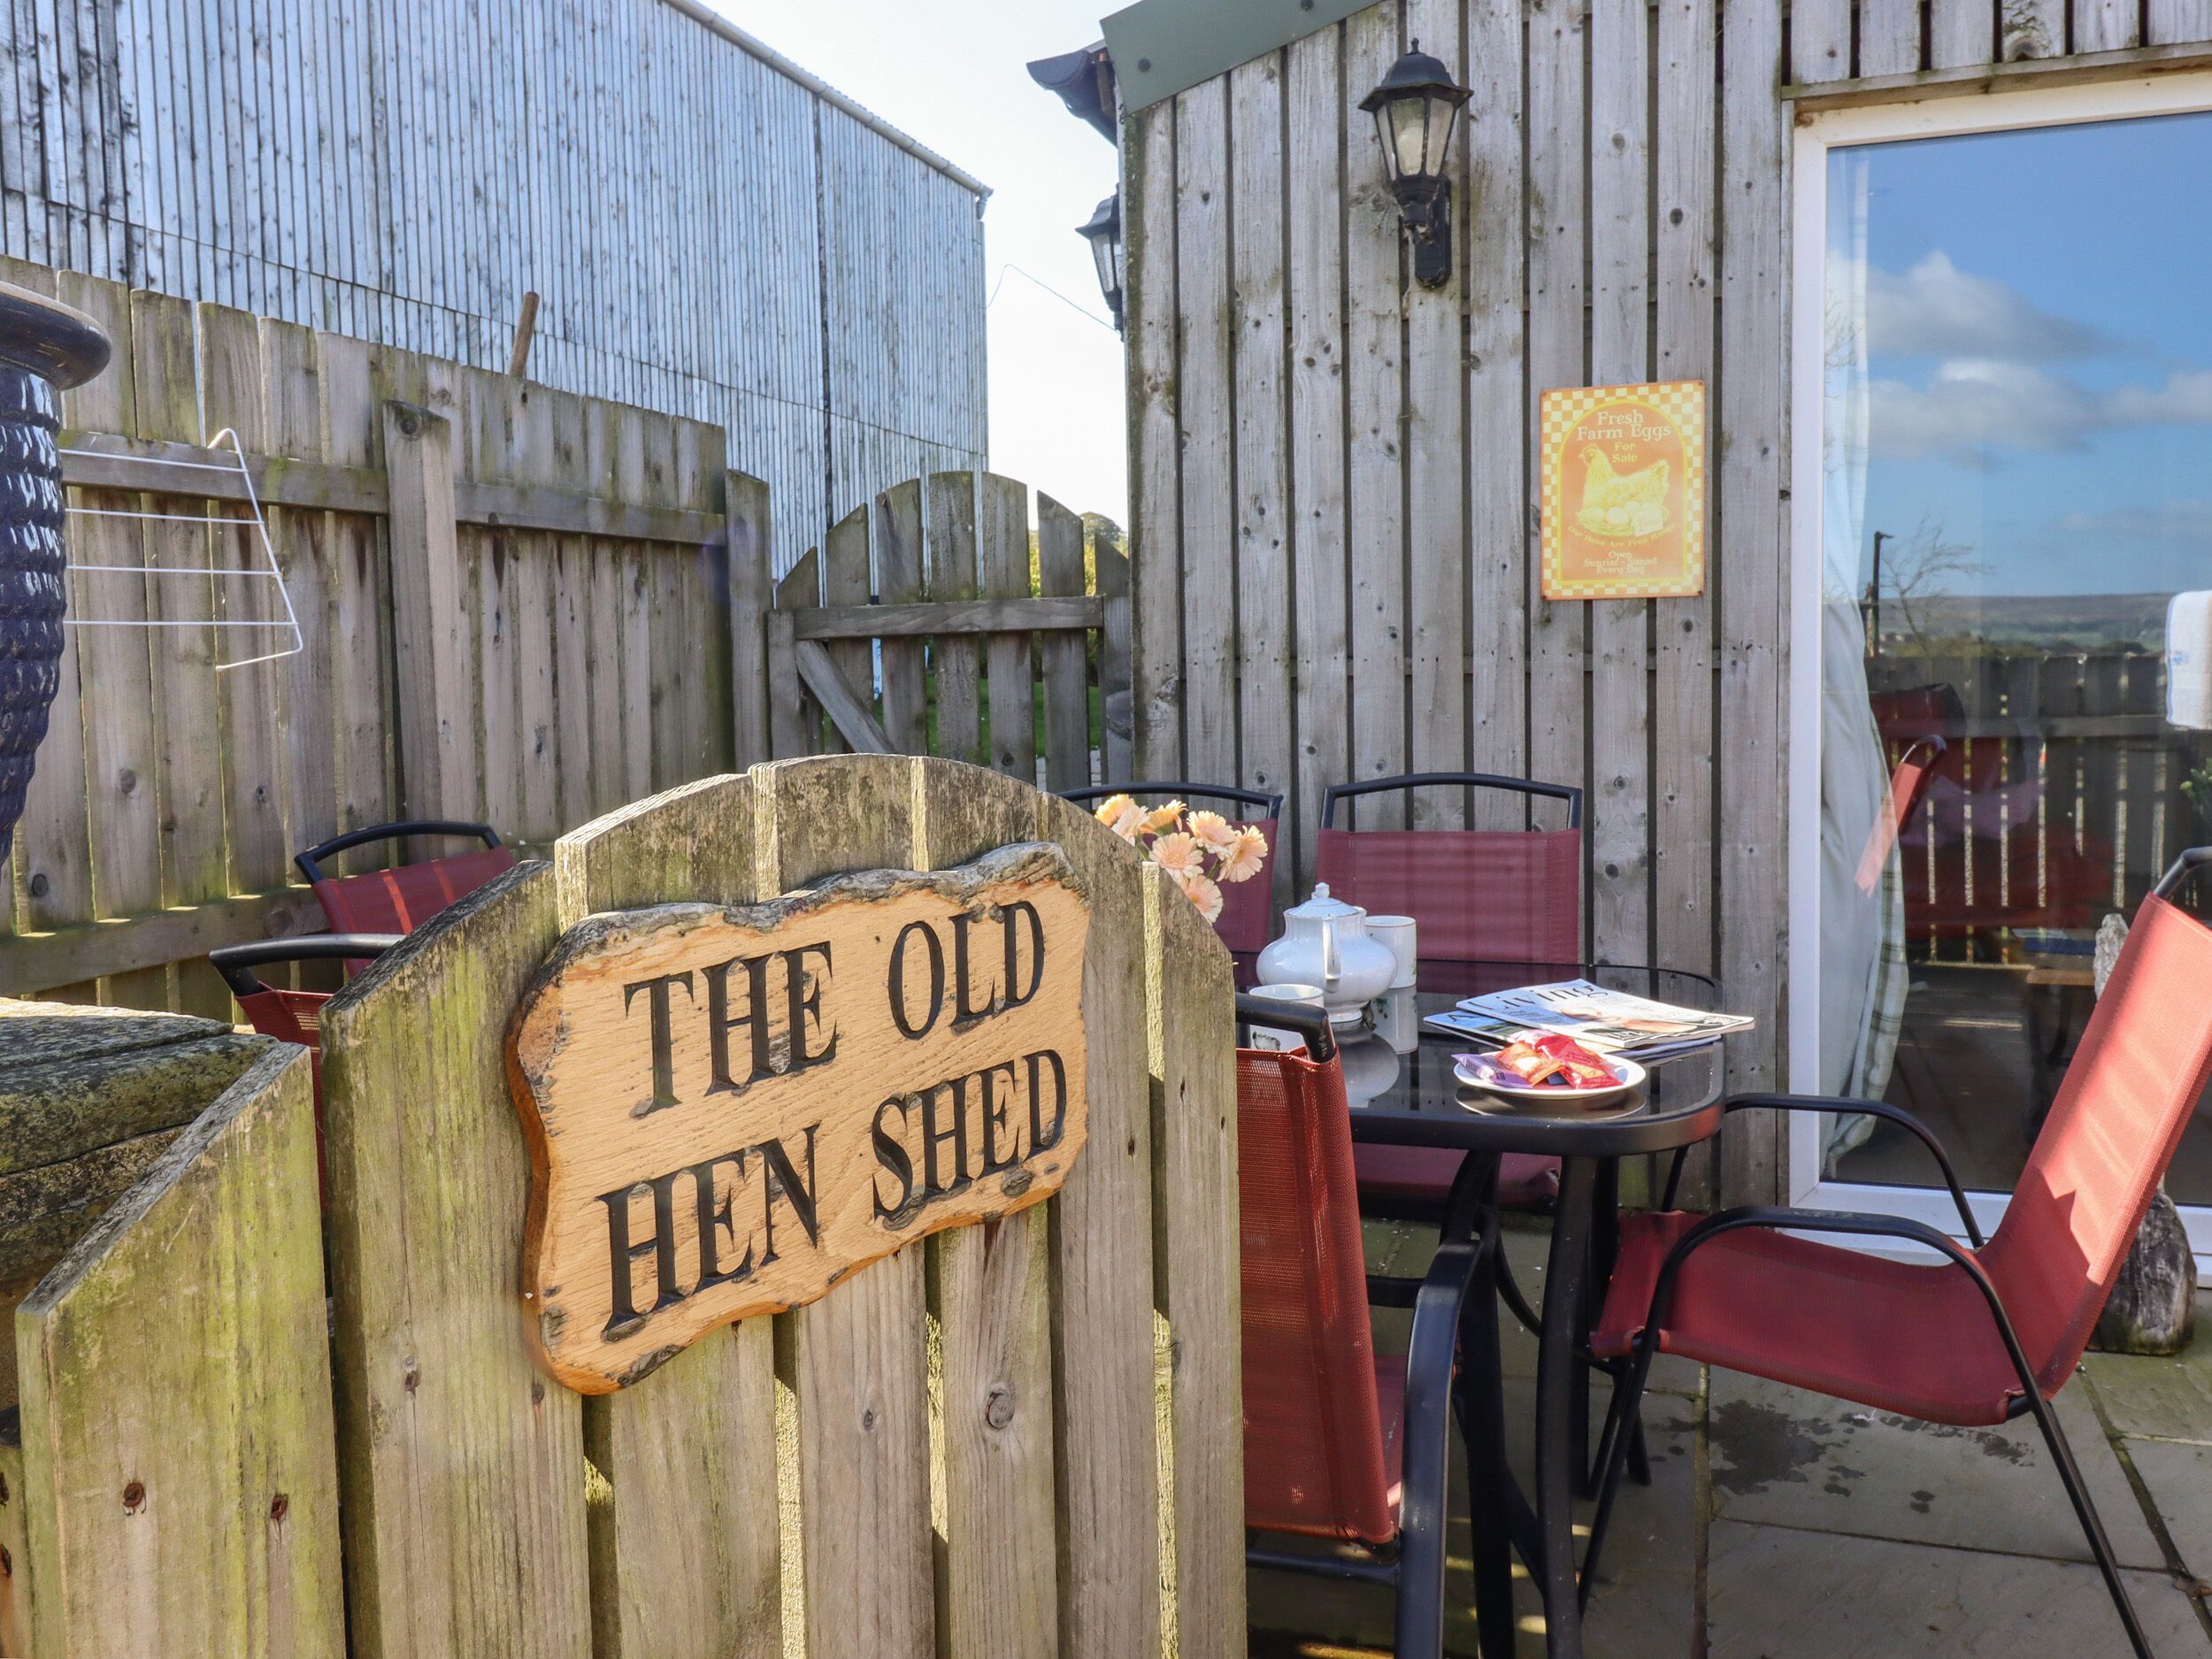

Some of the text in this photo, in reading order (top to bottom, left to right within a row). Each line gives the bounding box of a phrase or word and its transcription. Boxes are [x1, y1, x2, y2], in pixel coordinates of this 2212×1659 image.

[1597, 410, 1644, 426] Fresh
[1577, 423, 1671, 442] Farm Eggs
[1614, 442, 1635, 452] For
[1612, 452, 1639, 463] Sale
[1608, 550, 1632, 561] Open
[1467, 984, 1609, 1011] Living
[624, 900, 1045, 1117] THE OLD
[596, 1048, 1067, 1331] HEN SHED
